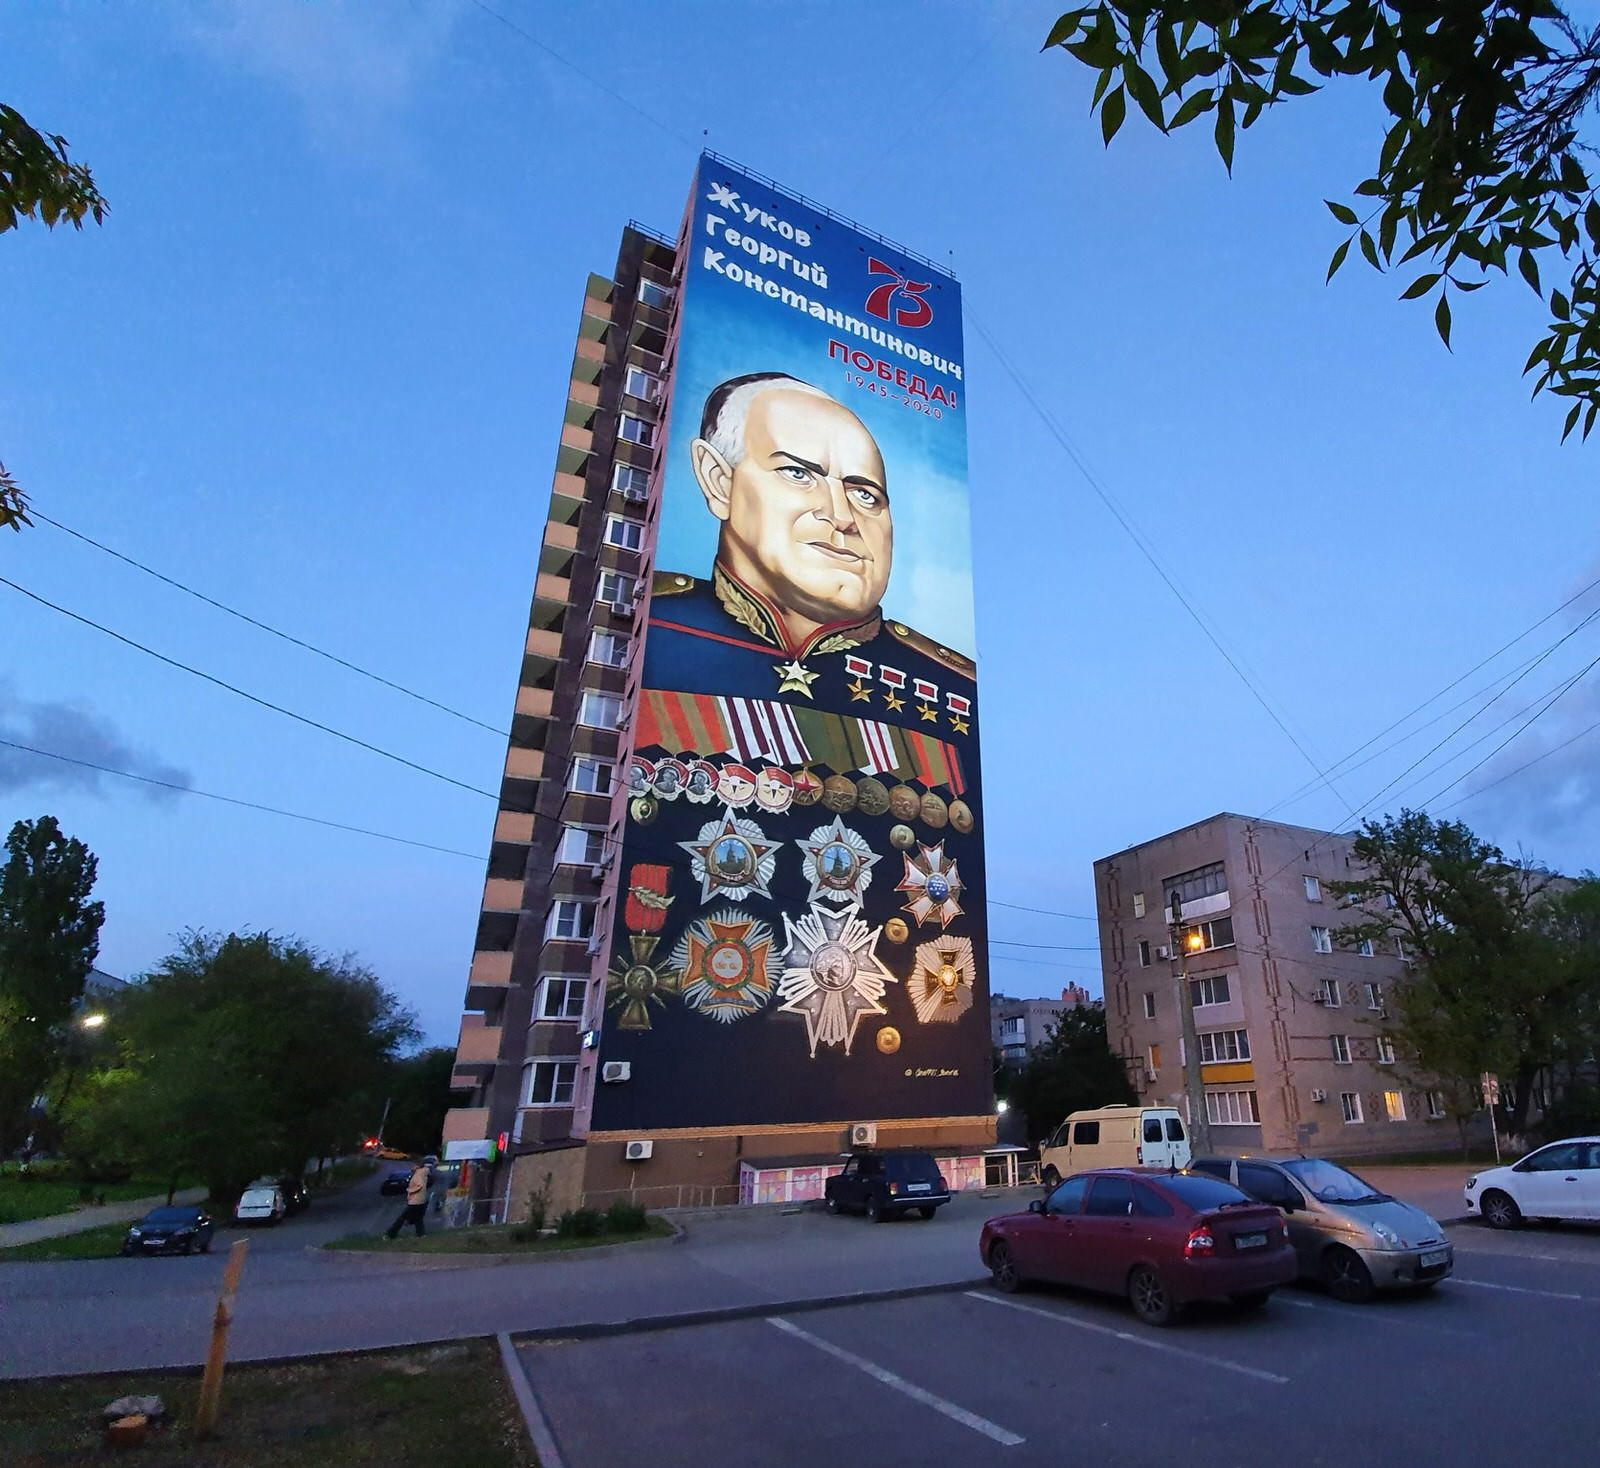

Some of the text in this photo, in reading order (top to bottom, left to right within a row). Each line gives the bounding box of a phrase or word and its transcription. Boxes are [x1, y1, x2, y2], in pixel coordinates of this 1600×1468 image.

[707, 182, 811, 246] Жуков
[705, 213, 828, 289] Георгий
[704, 248, 962, 380] Константинович
[865, 257, 933, 328] 75
[828, 339, 956, 409] ПОБЕДА!
